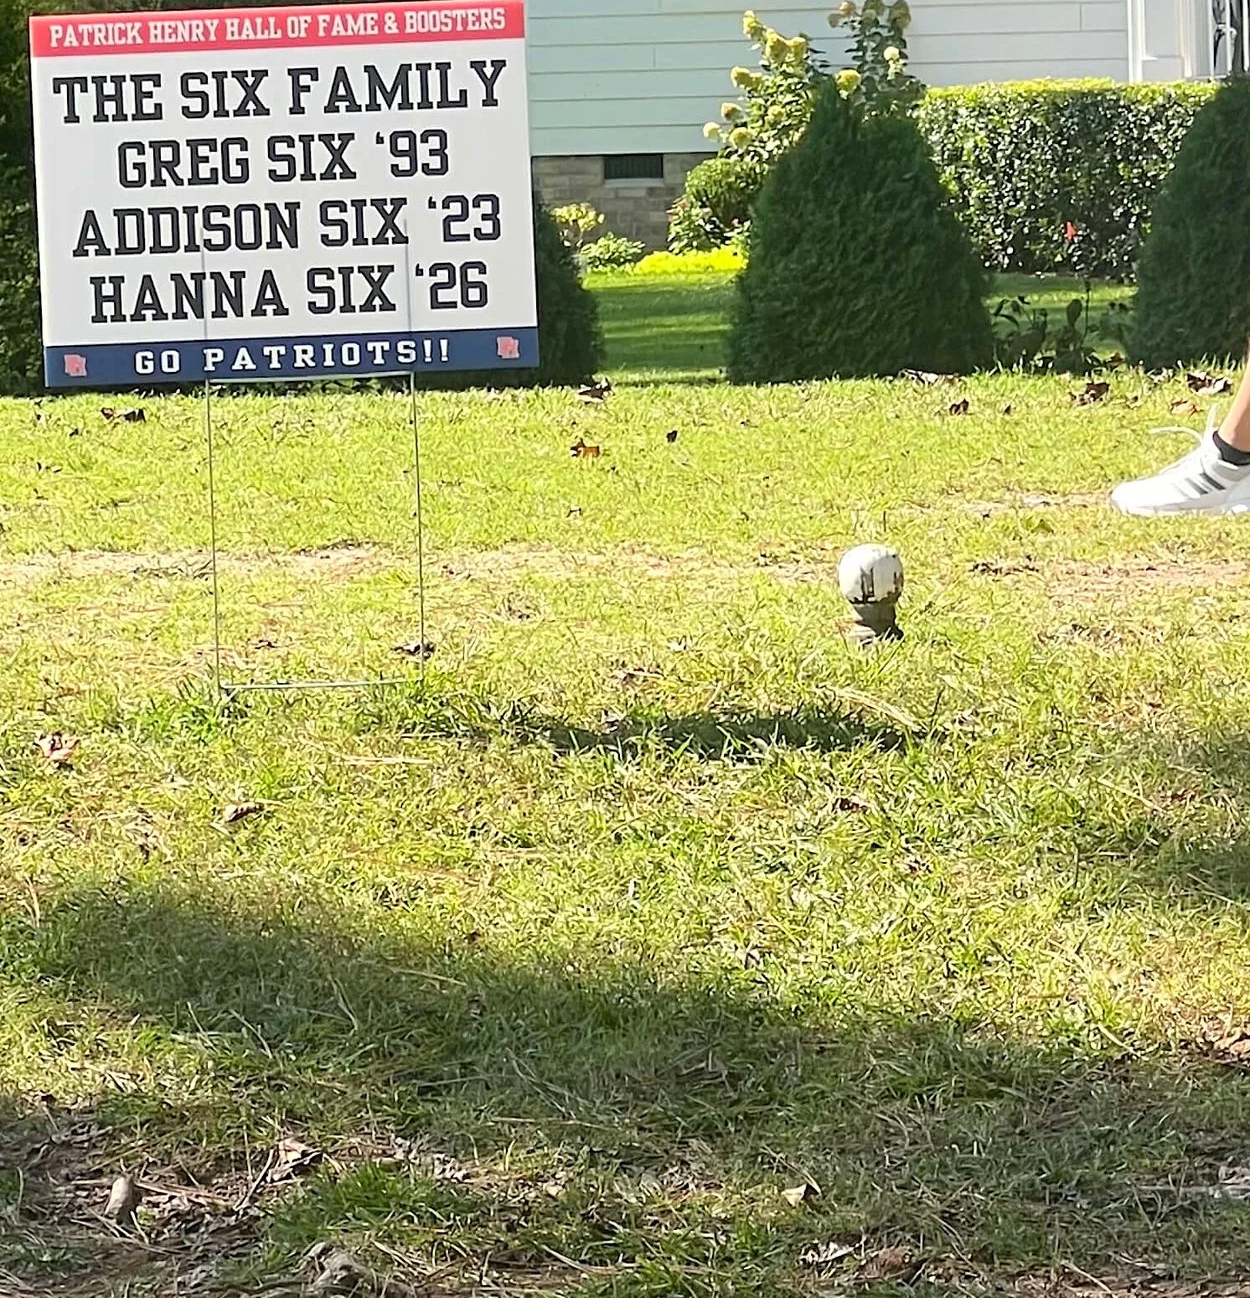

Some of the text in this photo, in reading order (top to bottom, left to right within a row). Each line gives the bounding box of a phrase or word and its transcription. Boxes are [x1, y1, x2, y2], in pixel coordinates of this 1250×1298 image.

[50, 8, 505, 47] PATRICK HENRY HALL OF FAME & BOOSTERS
[53, 59, 507, 124] THE SIX FAMILY
[118, 138, 249, 188] GREG
[267, 133, 357, 182] SIX
[72, 202, 301, 258] ADDISON
[320, 198, 408, 247] SIX
[90, 269, 288, 324] HANNA
[307, 265, 396, 314] SIX
[134, 339, 449, 375] GO PATRIOTS!!
